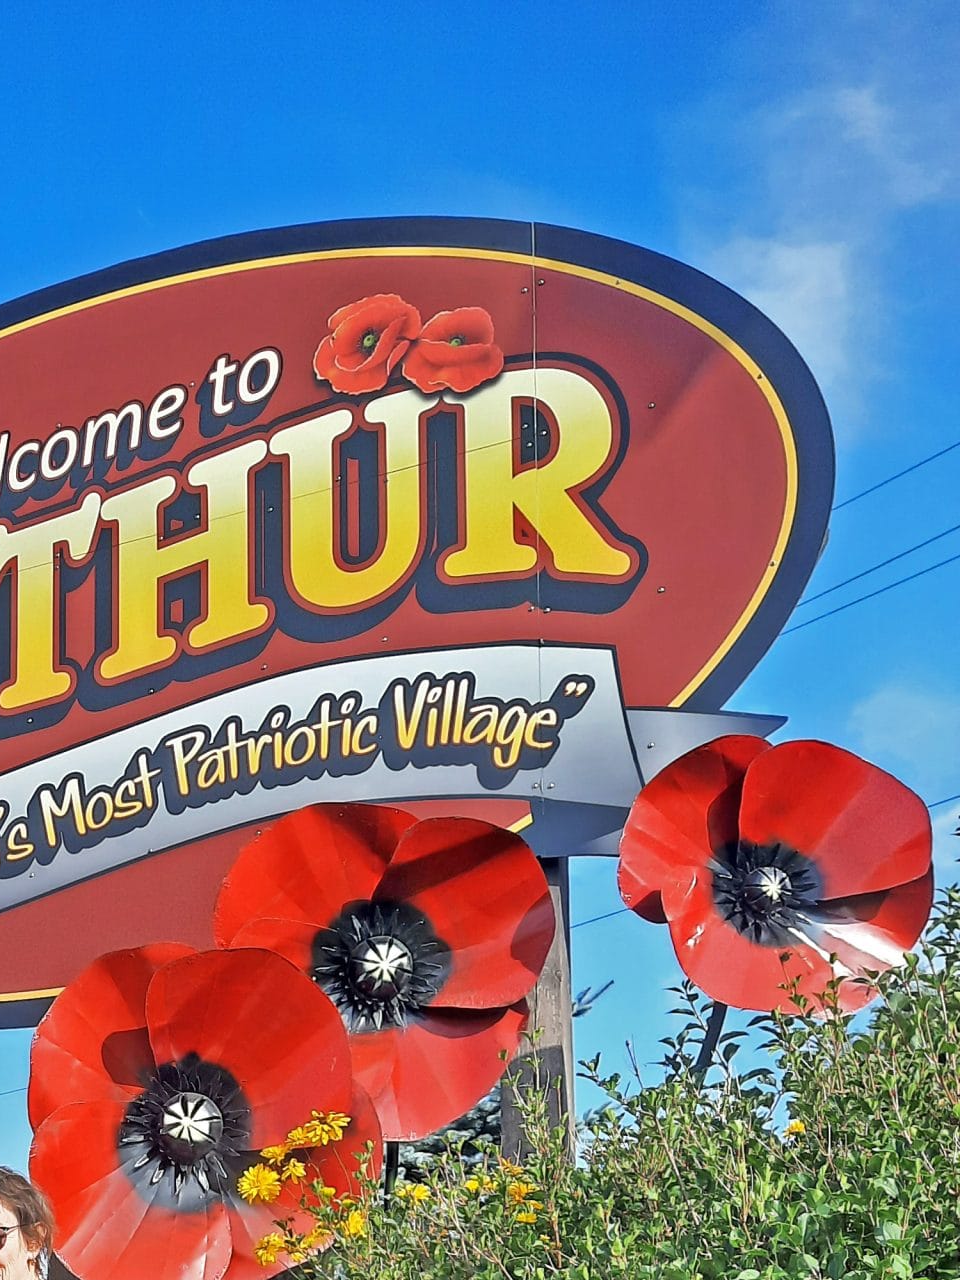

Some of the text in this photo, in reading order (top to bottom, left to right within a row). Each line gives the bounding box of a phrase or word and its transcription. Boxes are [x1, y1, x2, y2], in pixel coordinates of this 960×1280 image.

[208, 347, 280, 416] to
[38, 752, 162, 848] Most
[165, 698, 377, 796] Patriotic
